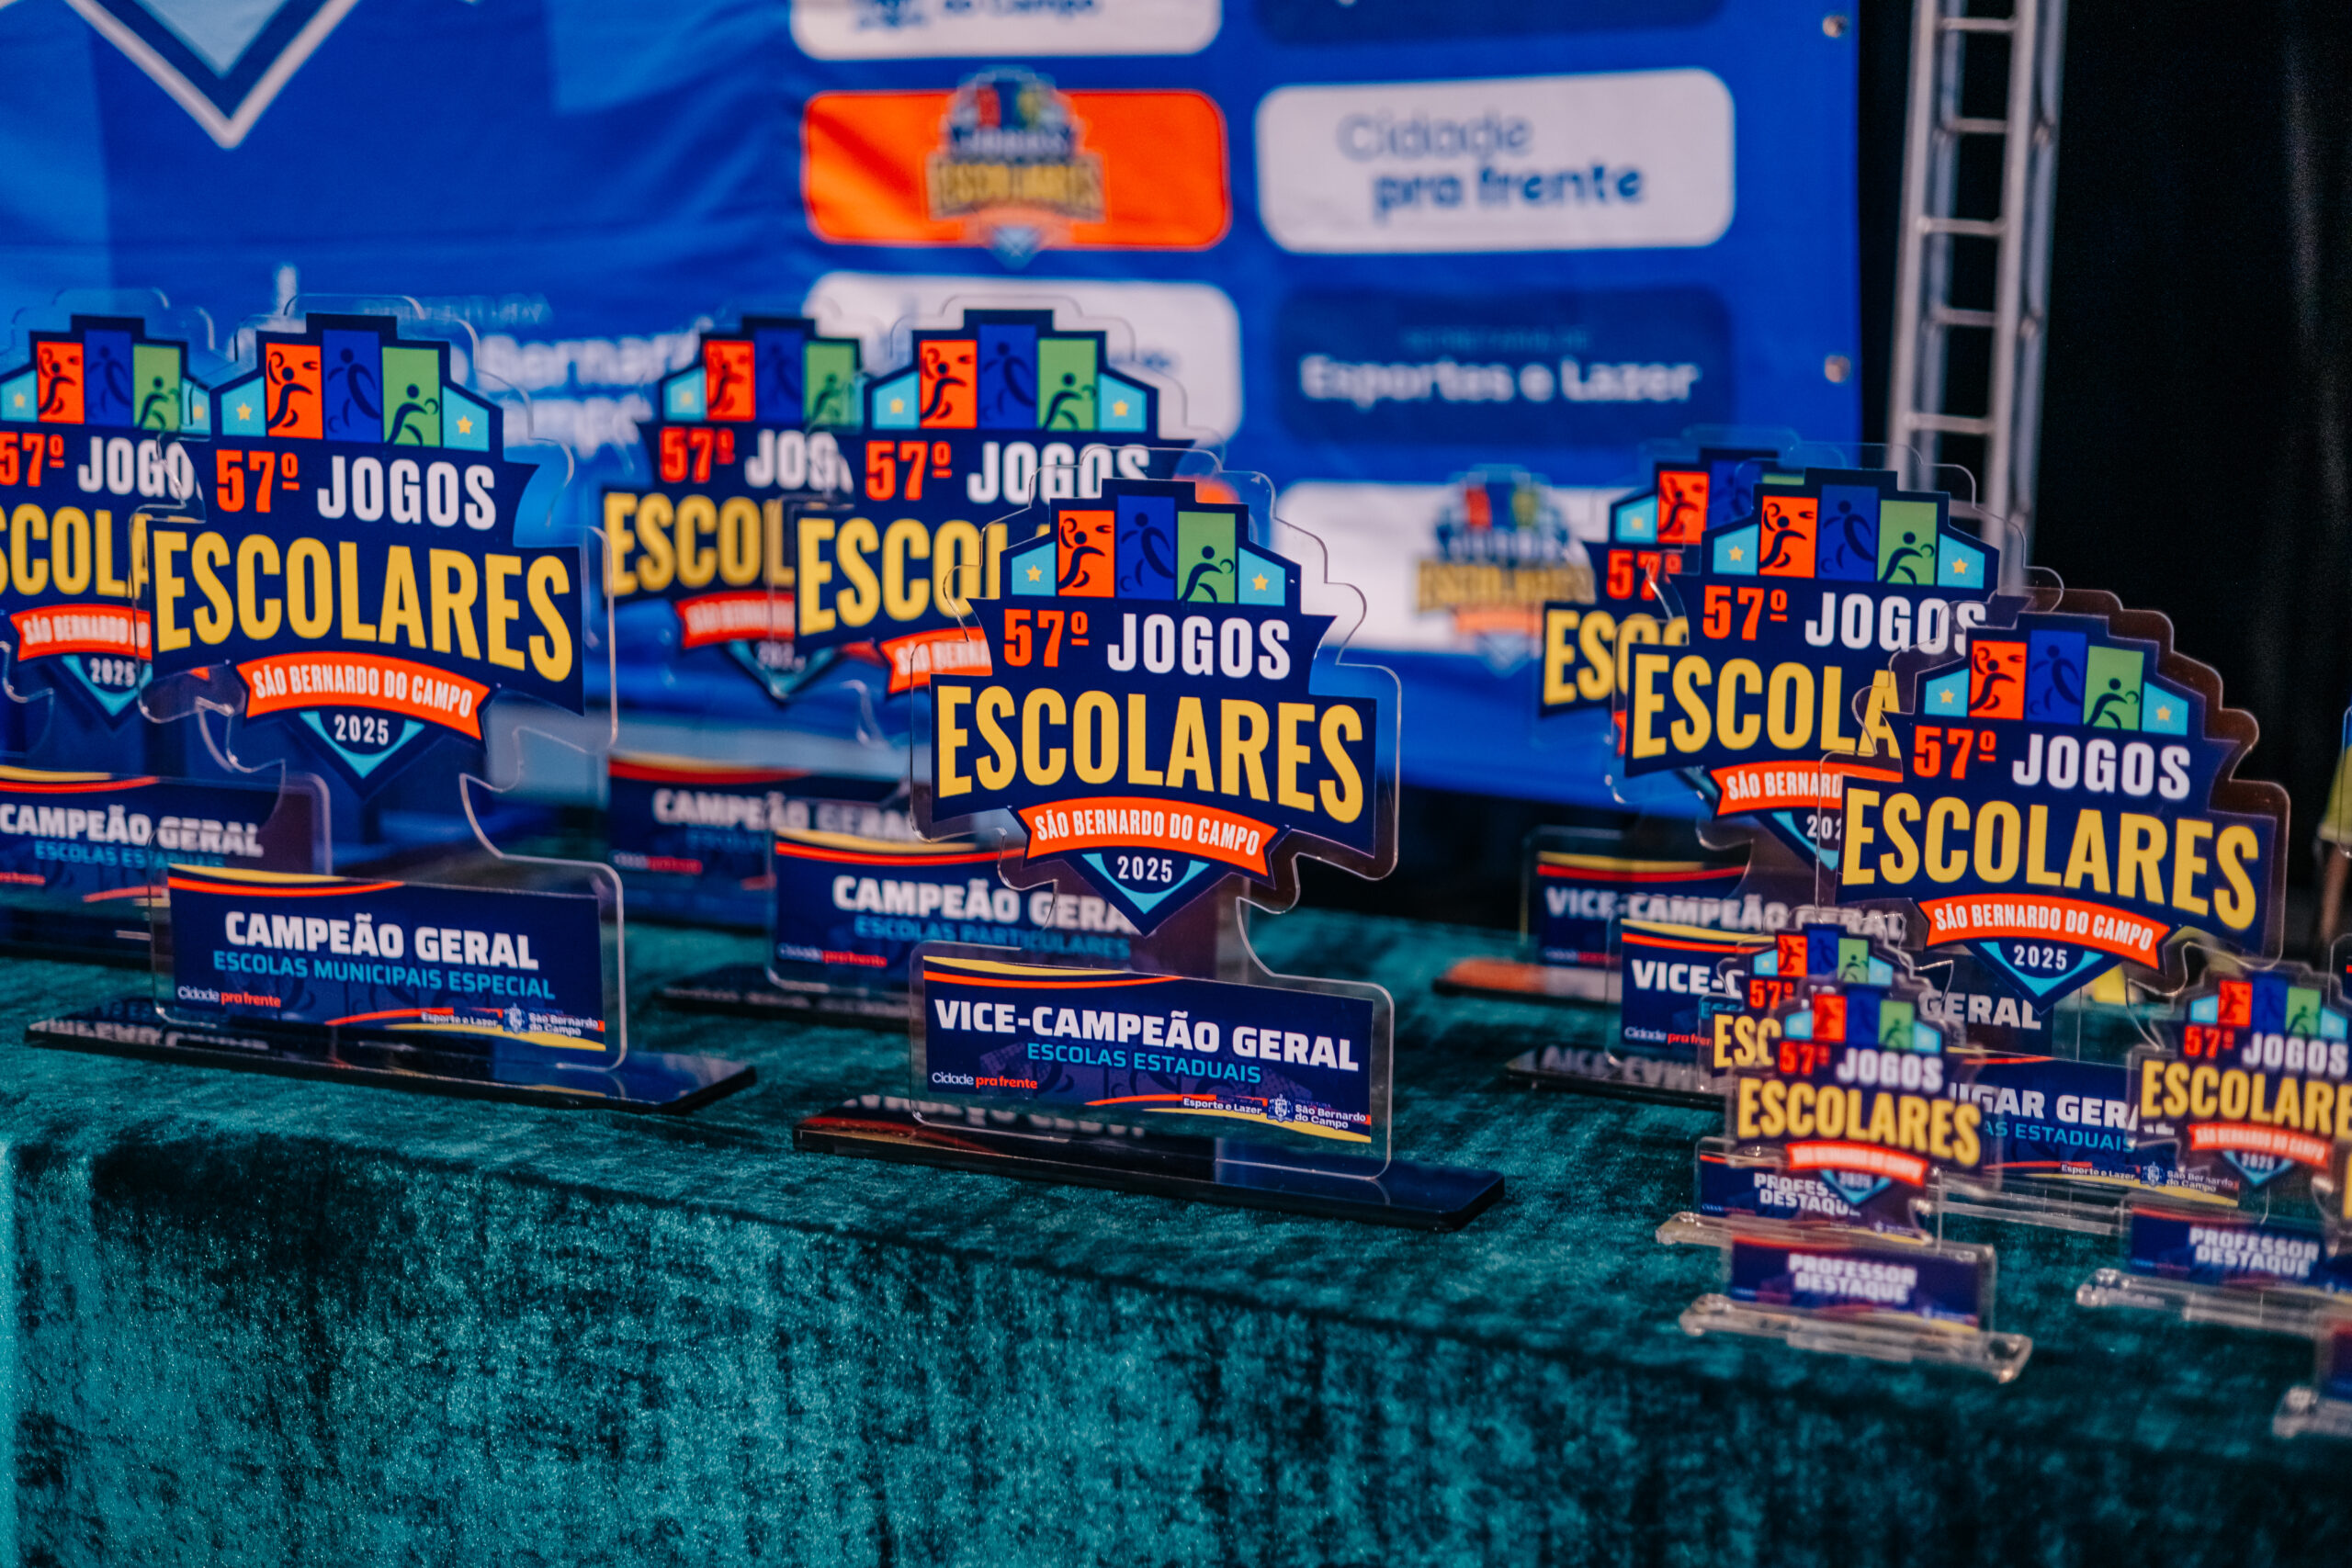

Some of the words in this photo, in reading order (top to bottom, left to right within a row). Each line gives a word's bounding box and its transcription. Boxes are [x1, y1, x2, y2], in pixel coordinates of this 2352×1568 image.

[78, 436, 204, 502] JOGO
[659, 426, 735, 483] 57º
[865, 441, 952, 501] 57º
[217, 450, 300, 513] 57º
[317, 455, 496, 530] JOGOS
[603, 492, 796, 597] ESCOL
[153, 530, 574, 682] ESCOLARES
[1703, 585, 1788, 640] 57º
[1805, 592, 1986, 655] JOGOS
[1003, 609, 1089, 667] 57º
[1107, 614, 1290, 680] JOGOS
[252, 666, 287, 700] SÃO
[290, 665, 380, 695] BERNARDO
[383, 671, 408, 698] DO
[411, 679, 474, 719] CAMPO
[1633, 653, 1902, 759] ESCOLA
[334, 715, 390, 747] 2025
[938, 684, 1363, 824] ESCOLARES
[1727, 770, 1760, 801] SÃO
[1765, 770, 1841, 797] BERNARD
[1913, 726, 1996, 780] 57º
[2012, 733, 2191, 802] JOGOS
[1035, 806, 1069, 841] SÃO
[1073, 808, 1164, 840] BERNARDO
[1169, 818, 1193, 840] DO
[1198, 823, 1261, 856] CAMPO
[1806, 813, 1841, 840] 202
[1117, 855, 1173, 883] 2025
[1841, 787, 2259, 931] ESCOLARES
[832, 874, 1021, 924] CAMPEÃO
[1028, 891, 1139, 935] GERA
[854, 915, 956, 942] ESCOLAS
[1934, 904, 1967, 931] SÃO
[1972, 904, 2062, 931] BERNARDO
[2064, 908, 2088, 936] DO
[2093, 913, 2154, 951] CAMPO
[225, 911, 404, 959] CAMPEÃO
[414, 926, 539, 970] GERAL
[2014, 946, 2068, 971] 2025
[177, 985, 220, 1003] Cidade
[220, 991, 244, 1008] pra
[243, 990, 281, 1008] frente
[213, 950, 309, 978] ESCOLAS
[313, 957, 442, 992] MUNICIPAIS
[448, 969, 556, 1000] ESPECIAL
[935, 996, 1220, 1052] VICE-CAMPEÃO
[1233, 1026, 1358, 1072] GERAL
[1918, 991, 2041, 1031] GERAL
[932, 1070, 974, 1087] Cidade
[976, 1074, 999, 1090] pra
[999, 1074, 1037, 1090] frente
[1027, 1043, 1127, 1070] ESCOLAS
[1133, 1051, 1261, 1085] ESTADUAIS
[1838, 1048, 1943, 1092] JOGOS
[2242, 1033, 2349, 1077] JOGOS
[1183, 1098, 1223, 1110] Esporte
[1234, 1103, 1261, 1115] Lazer
[1295, 1103, 1316, 1115] São
[1317, 1108, 1366, 1122] Bernardo
[1295, 1112, 1309, 1122] do
[1311, 1114, 1349, 1130] Campo
[1738, 1077, 1982, 1167] ESCOLARES
[2141, 1059, 2352, 1146] ESCOLARE
[2015, 1122, 2135, 1154] ESTADUAIS
[2189, 1226, 2320, 1261] PROFESSOR
[2195, 1245, 2312, 1279] DESTAQUE
